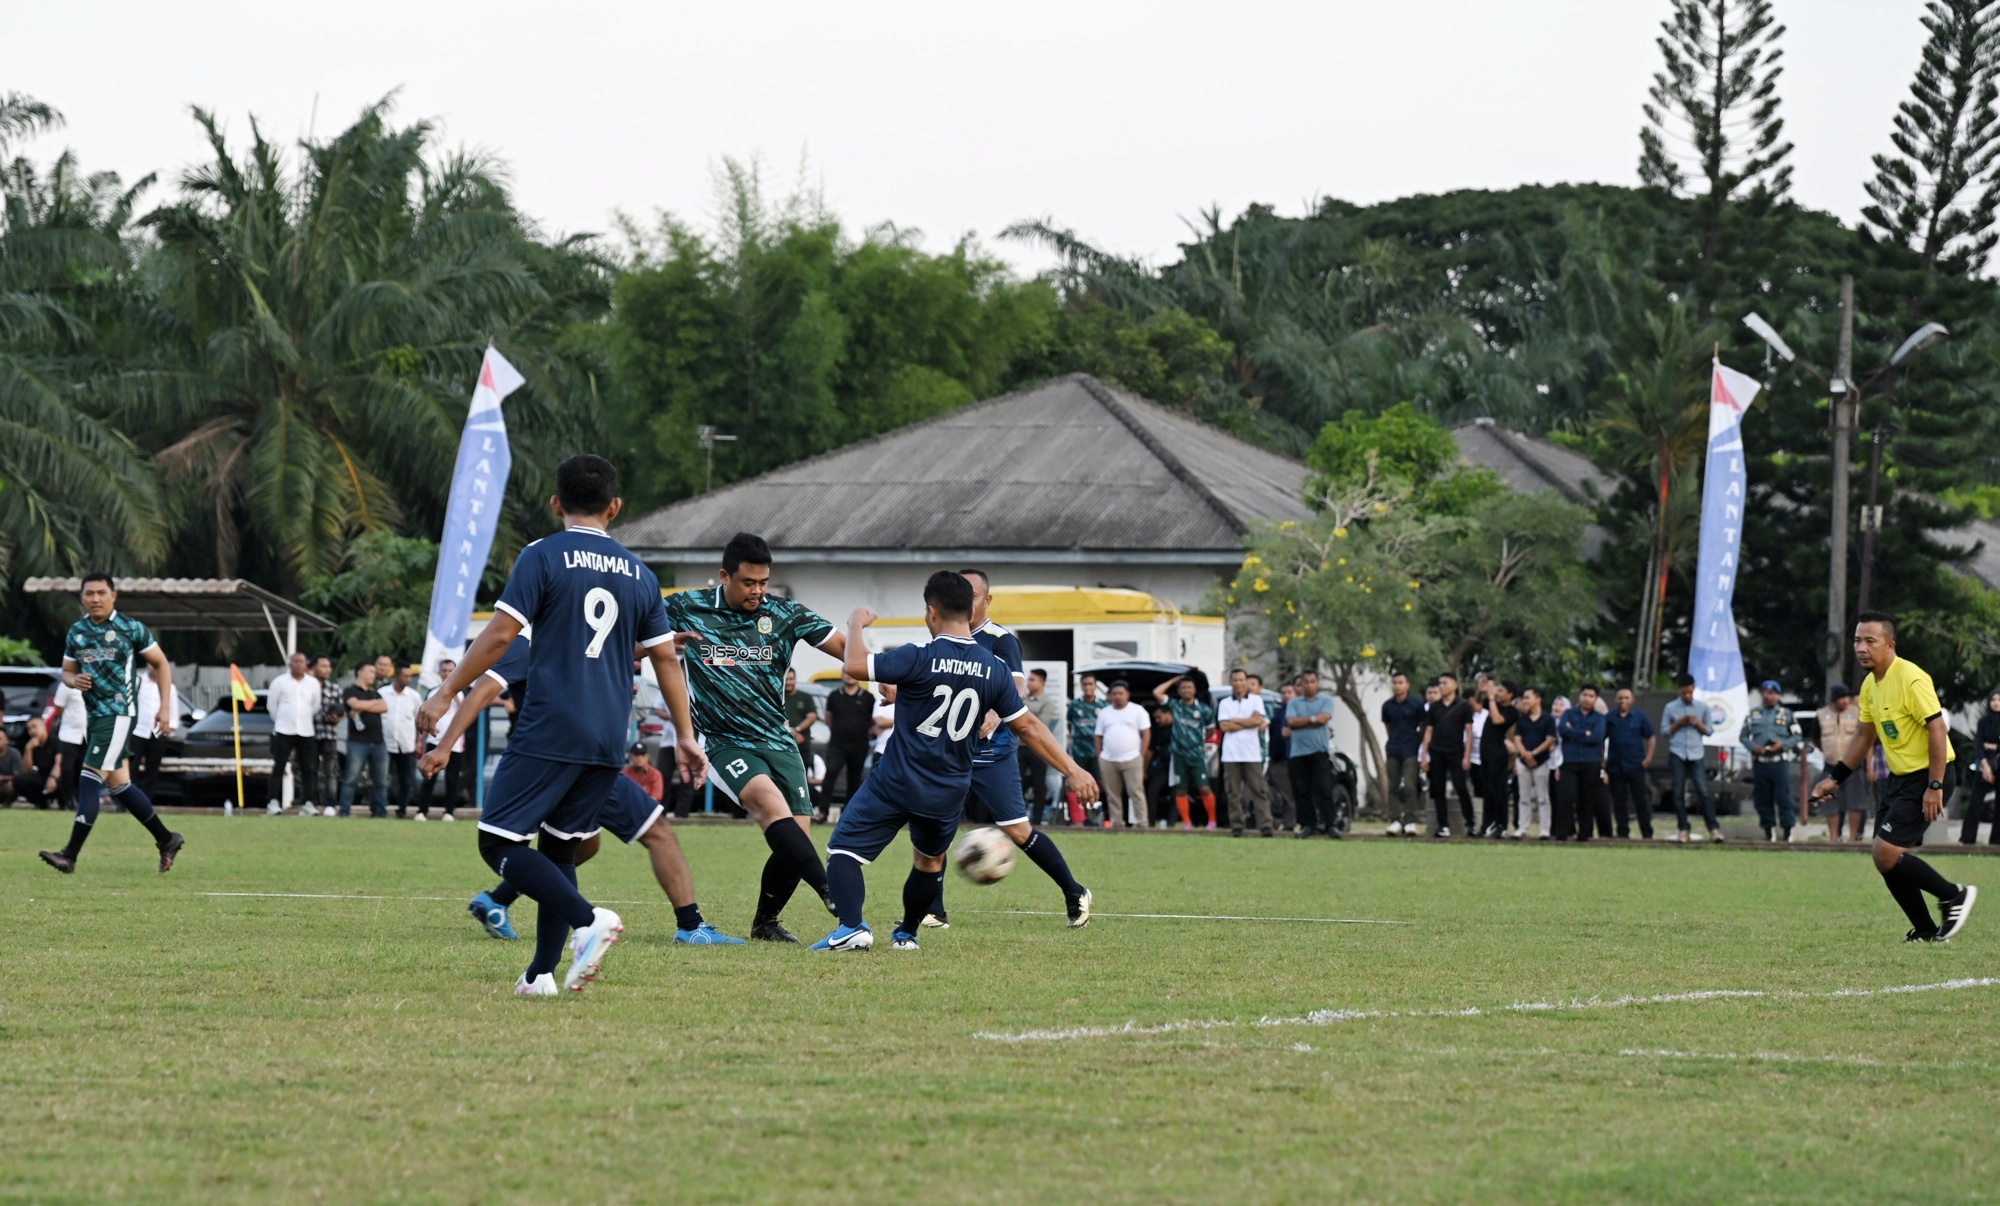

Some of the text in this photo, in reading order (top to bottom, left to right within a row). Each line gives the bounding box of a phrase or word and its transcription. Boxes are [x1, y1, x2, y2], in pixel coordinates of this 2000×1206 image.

[456, 436, 497, 598] LANTAMAL
[563, 549, 633, 577] LANTAMAL
[1709, 457, 1742, 637] LANTAMAL
[583, 586, 619, 658] 9
[700, 644, 773, 660] DISPORA
[915, 684, 980, 742] 20
[725, 758, 749, 779] 13
